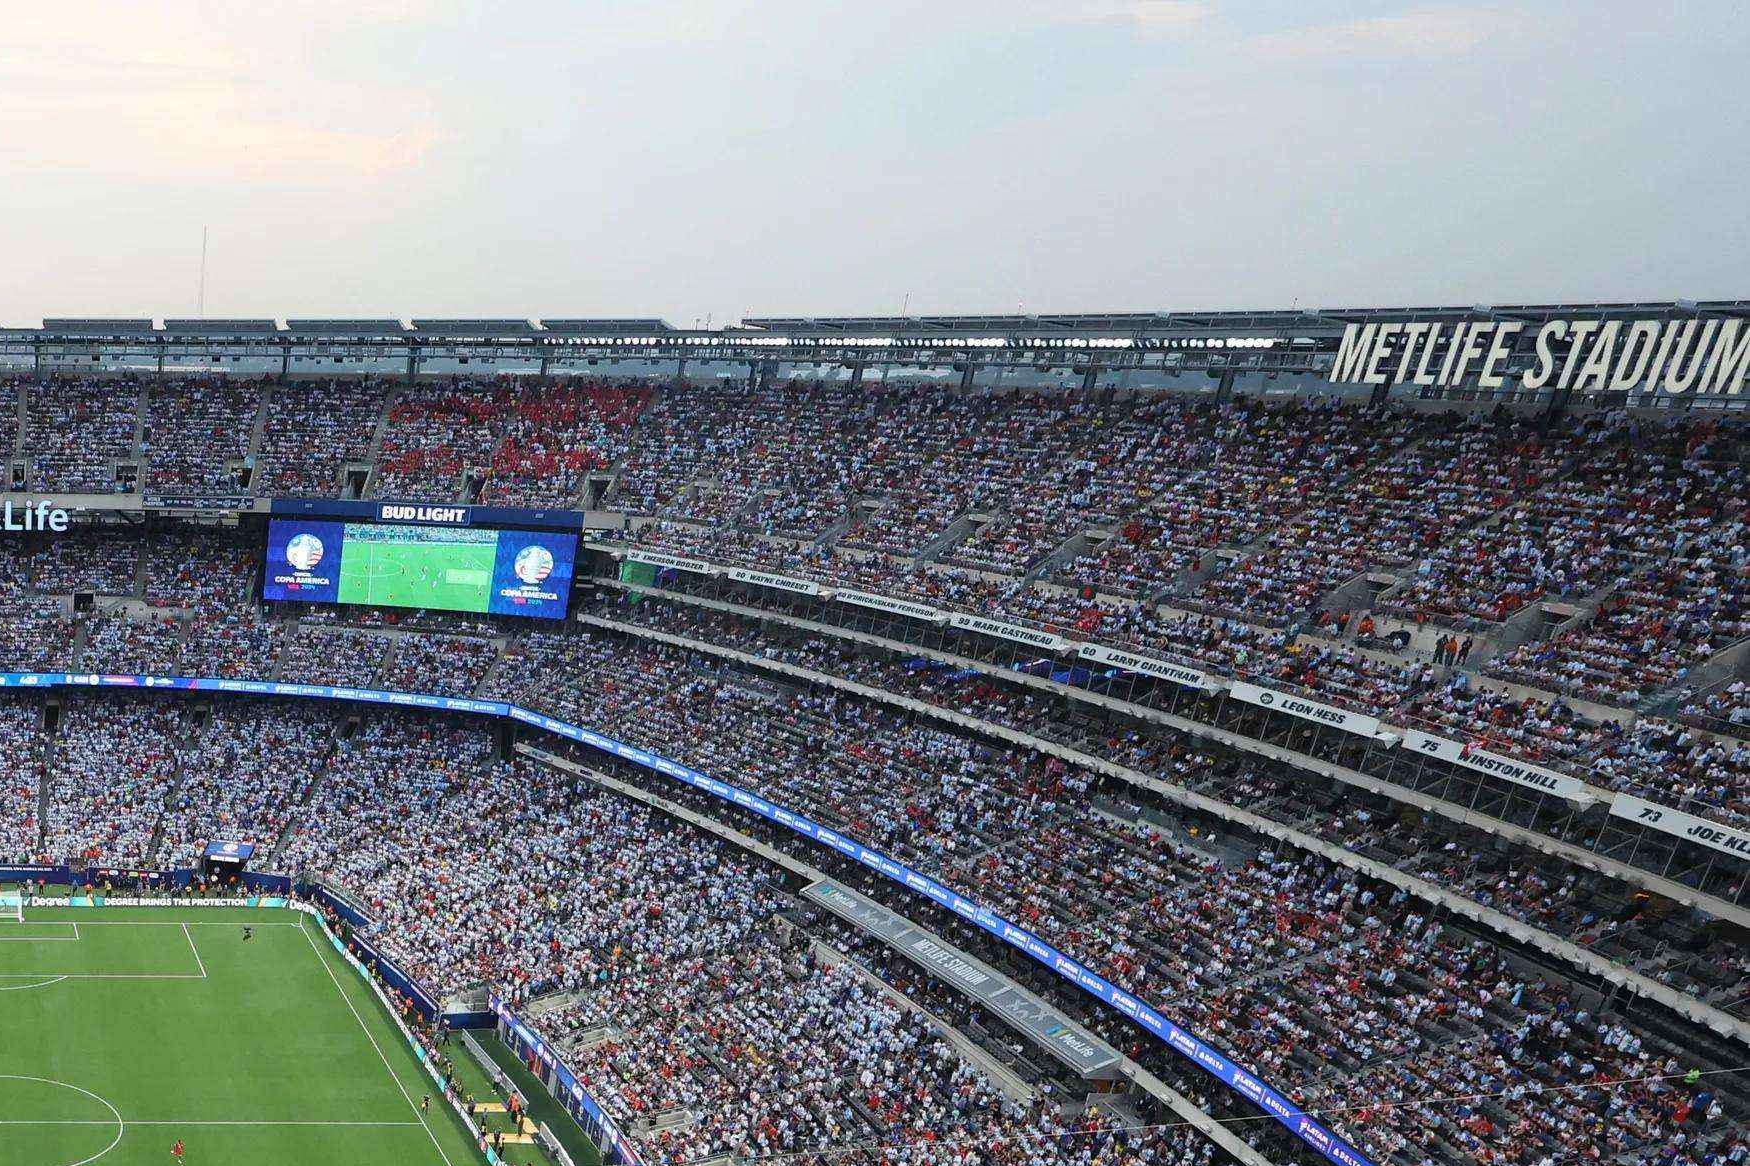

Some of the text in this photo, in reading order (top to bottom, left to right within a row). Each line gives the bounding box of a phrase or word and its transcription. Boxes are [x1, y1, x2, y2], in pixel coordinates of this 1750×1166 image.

[1330, 319, 1750, 394] METLIFE STADIUM
[382, 505, 467, 523] BUD LIGHT
[750, 573, 774, 585] WAYNE
[500, 589, 521, 598] COPA
[898, 604, 934, 618] FERGUSON
[972, 620, 1001, 632] MARK
[1001, 626, 1053, 645] GASTINEAU
[1107, 652, 1140, 669] LARRY
[1141, 661, 1201, 684] GRANTHAM
[1281, 699, 1312, 716] LEON
[1313, 708, 1346, 725] HESS
[1420, 739, 1557, 791] 75 WINSTON HILL
[1638, 807, 1663, 823] 73
[1687, 825, 1722, 843] JOE
[31, 897, 70, 907] Degree
[104, 897, 248, 907] DEGREE BRINGS THE PROTECTION
[912, 939, 990, 985] METLIFE STADIUM
[1060, 1032, 1094, 1057] MetLife
[1174, 1031, 1196, 1049] LATAM
[1240, 1074, 1262, 1093] LATAM
[1271, 1099, 1291, 1118] DELTA
[1306, 1122, 1329, 1143] LATAM
